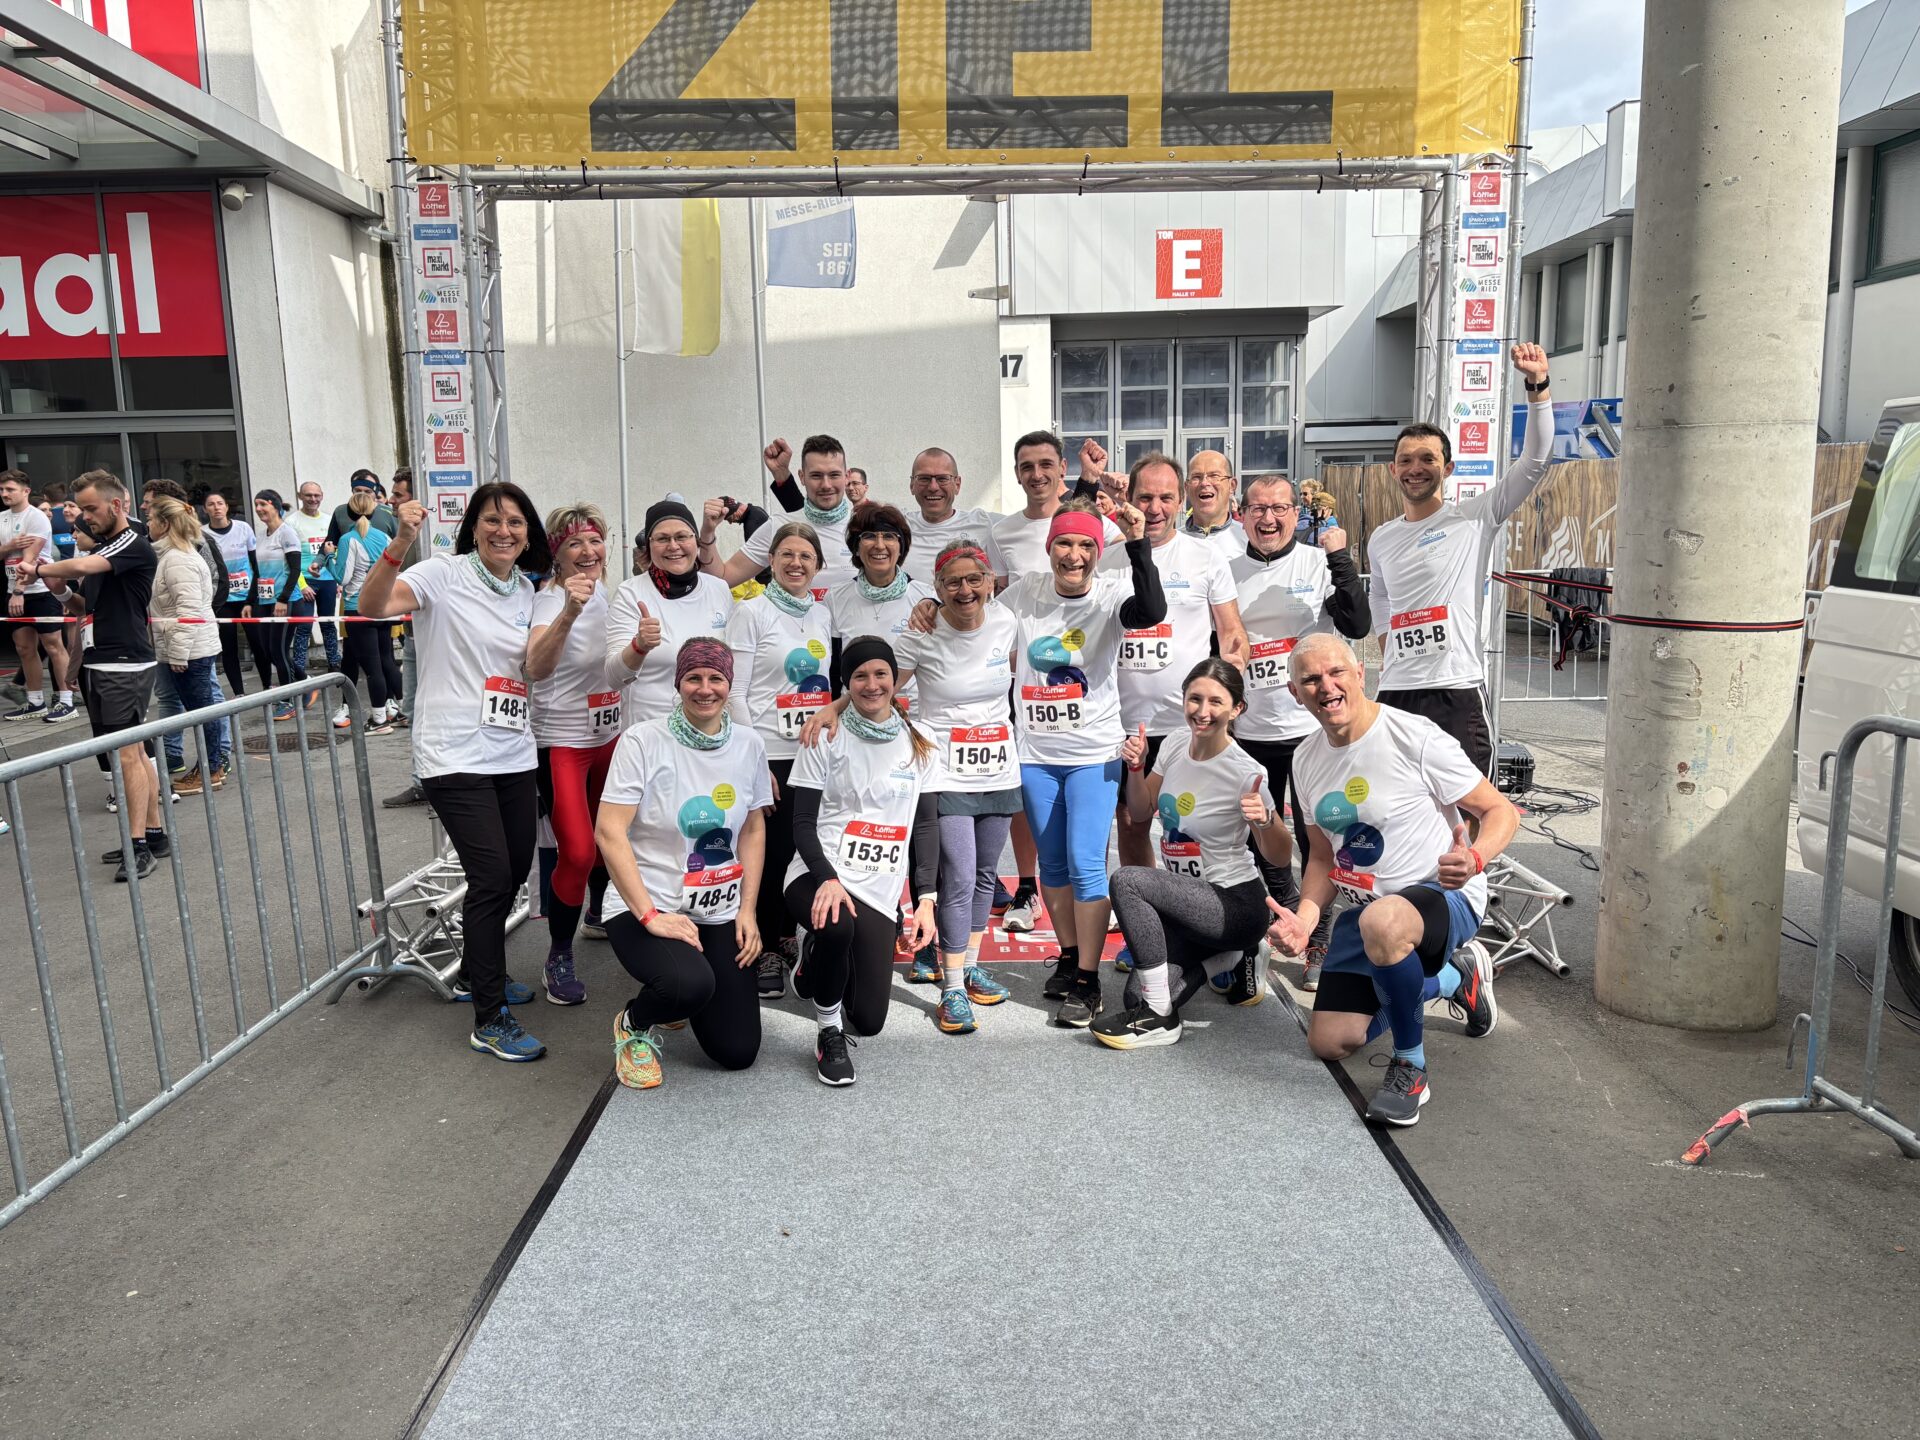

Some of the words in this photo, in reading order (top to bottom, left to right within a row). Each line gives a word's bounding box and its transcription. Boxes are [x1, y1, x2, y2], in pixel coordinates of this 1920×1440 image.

[589, 0, 1334, 152] ZIEL
[1157, 230, 1174, 240] TOR
[1172, 239, 1203, 290] E
[440, 296, 458, 304] RIED
[999, 354, 1024, 378] 17
[1408, 609, 1432, 621] Löffler
[1260, 641, 1285, 651] Löffler
[1395, 625, 1446, 650] 153-B
[1119, 641, 1168, 660] 151-C
[1246, 657, 1290, 681] 152-
[1042, 686, 1068, 695] Löffler
[1266, 678, 1280, 687] 1520
[802, 693, 823, 701] Löffler
[1026, 702, 1081, 723] 150-B
[978, 728, 1001, 736] Löffler
[955, 745, 1008, 766] 150-A
[874, 825, 897, 835] Löffler
[847, 840, 900, 864] 153-C
[864, 864, 879, 872] 1532
[688, 883, 738, 910] 148-C
[1245, 955, 1255, 996] BROOKS
